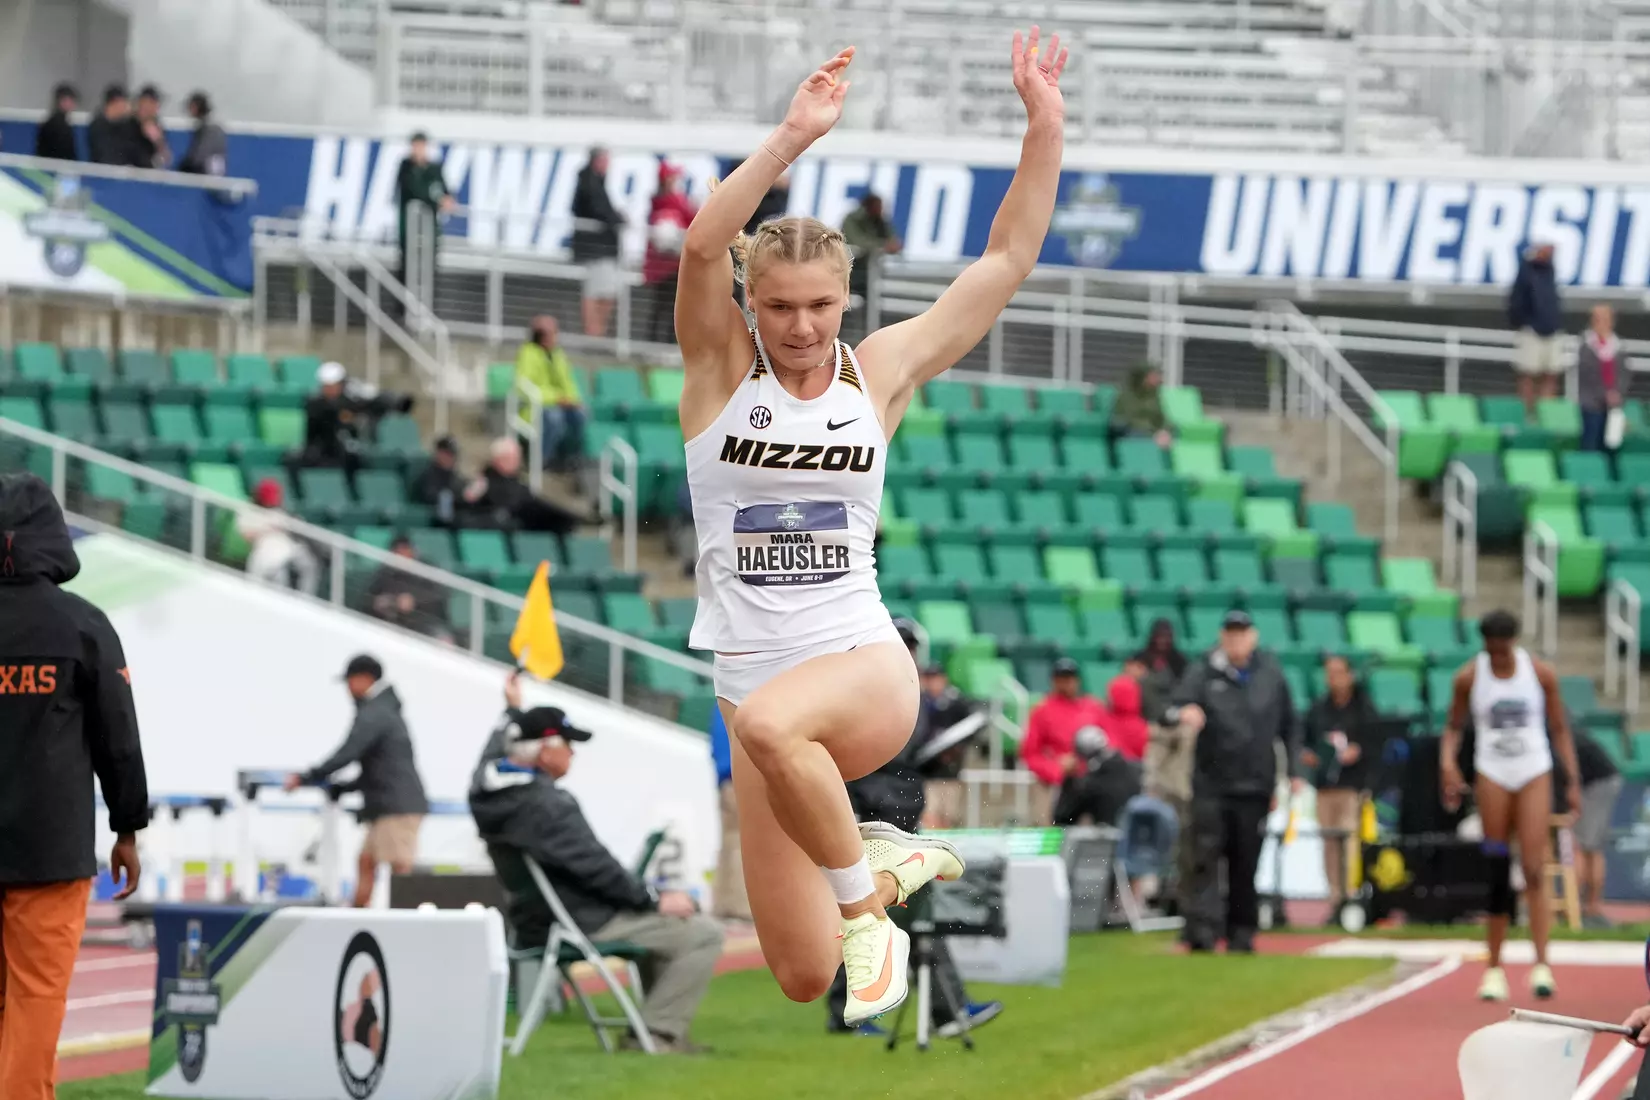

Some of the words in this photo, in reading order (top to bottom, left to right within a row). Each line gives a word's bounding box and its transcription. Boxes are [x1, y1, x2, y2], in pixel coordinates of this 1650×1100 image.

[751, 406, 771, 428] SEC
[719, 434, 875, 473] MIZZOU
[770, 533, 814, 544] MARA
[737, 545, 850, 571] HAEUSLER
